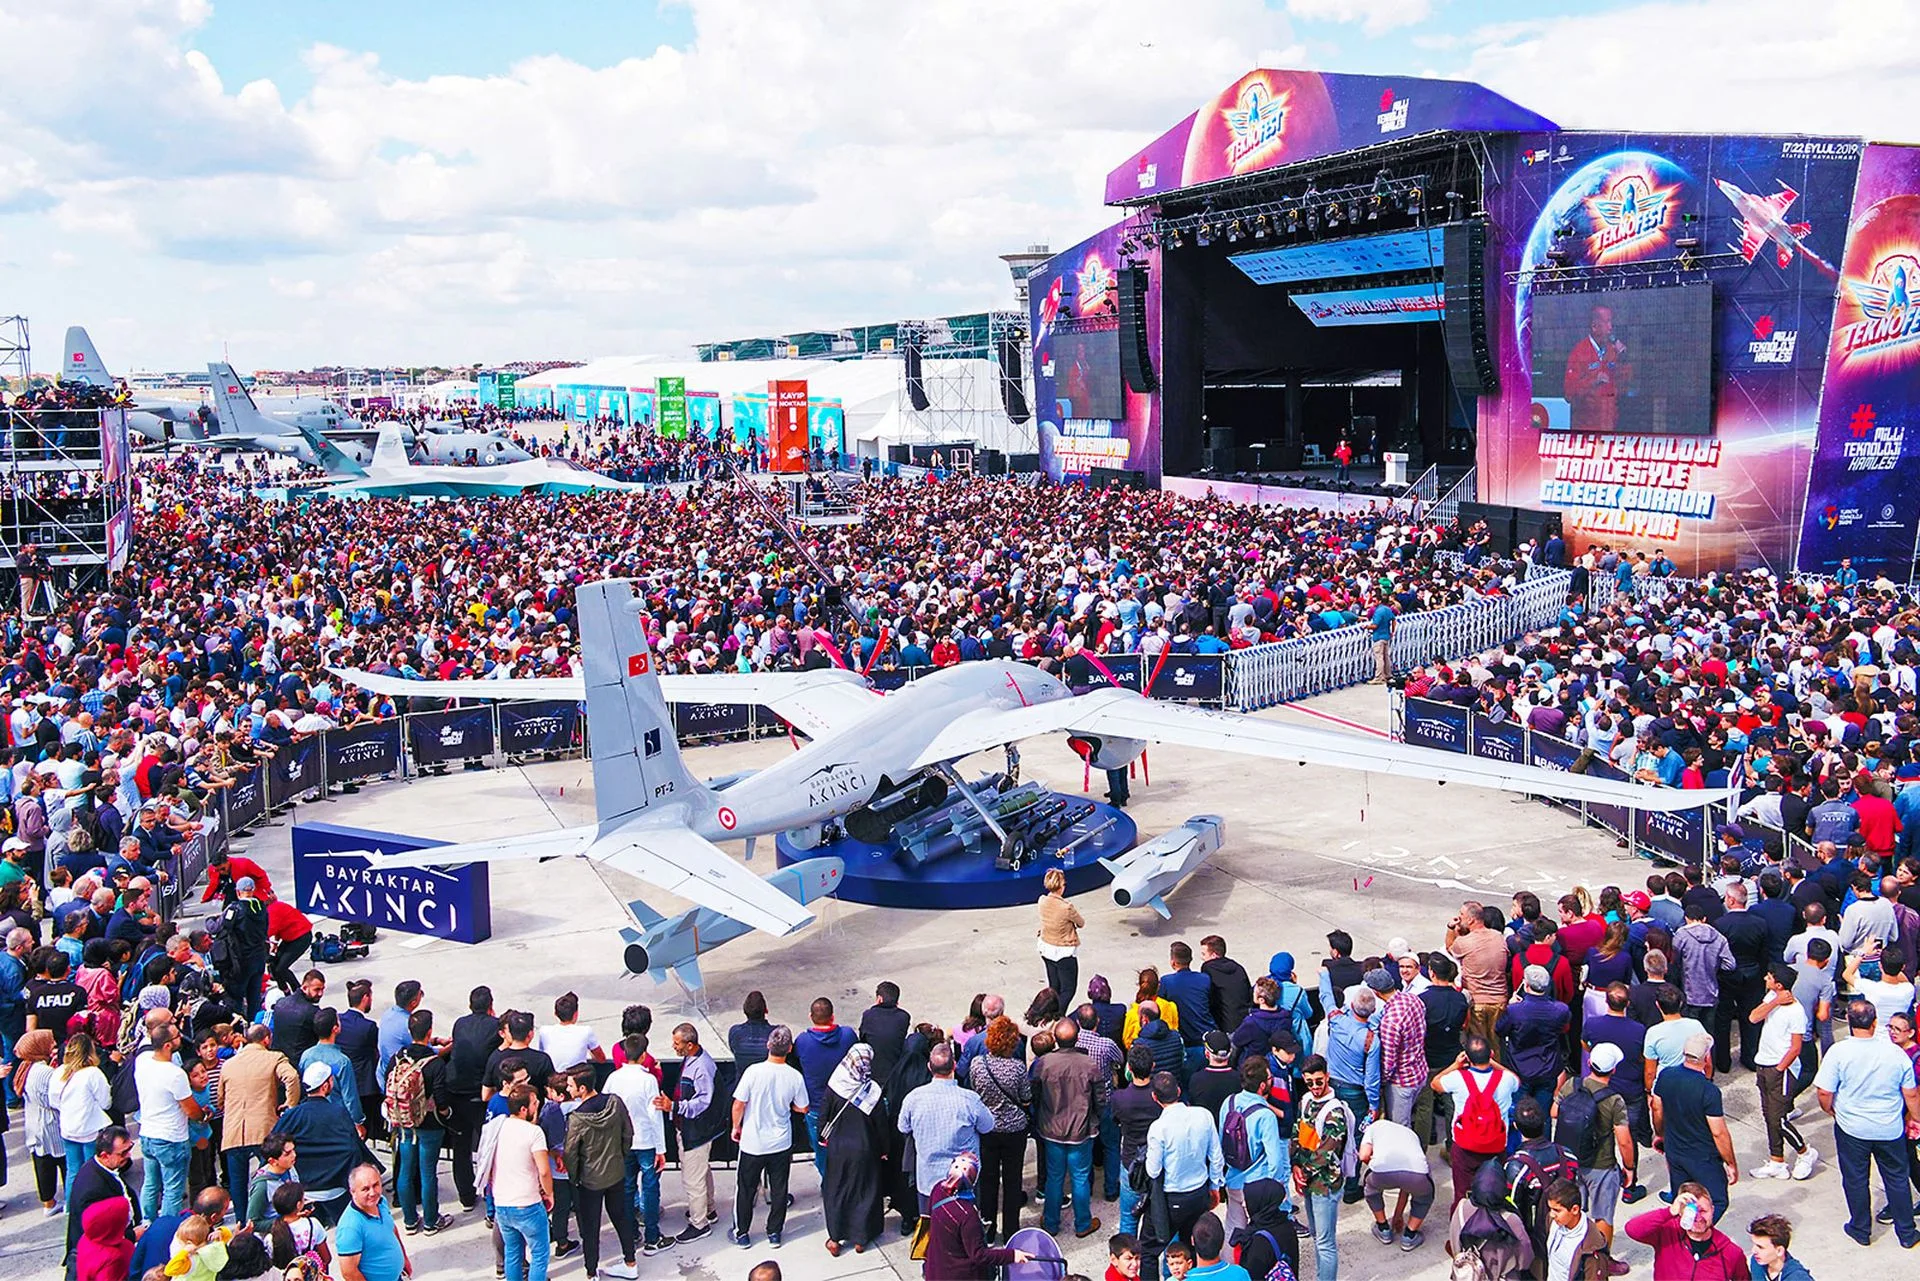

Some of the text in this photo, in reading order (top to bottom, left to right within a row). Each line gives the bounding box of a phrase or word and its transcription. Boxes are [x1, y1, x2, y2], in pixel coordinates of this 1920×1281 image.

[1597, 203, 1668, 251] TEKNOFEST
[1541, 480, 1716, 519] GELECEK BURADA
[690, 708, 733, 720] AKINCI
[514, 724, 562, 736] AKINCI
[1416, 726, 1455, 742] AKINCI
[339, 749, 385, 764] AKINCI
[810, 767, 854, 789] BAYRAKTAR
[654, 781, 675, 798] PT-2
[808, 774, 867, 808] AKINCI
[326, 864, 436, 896] BAYRAKTAR
[308, 880, 458, 933] AKINCI
[36, 994, 73, 1008] AFAD
